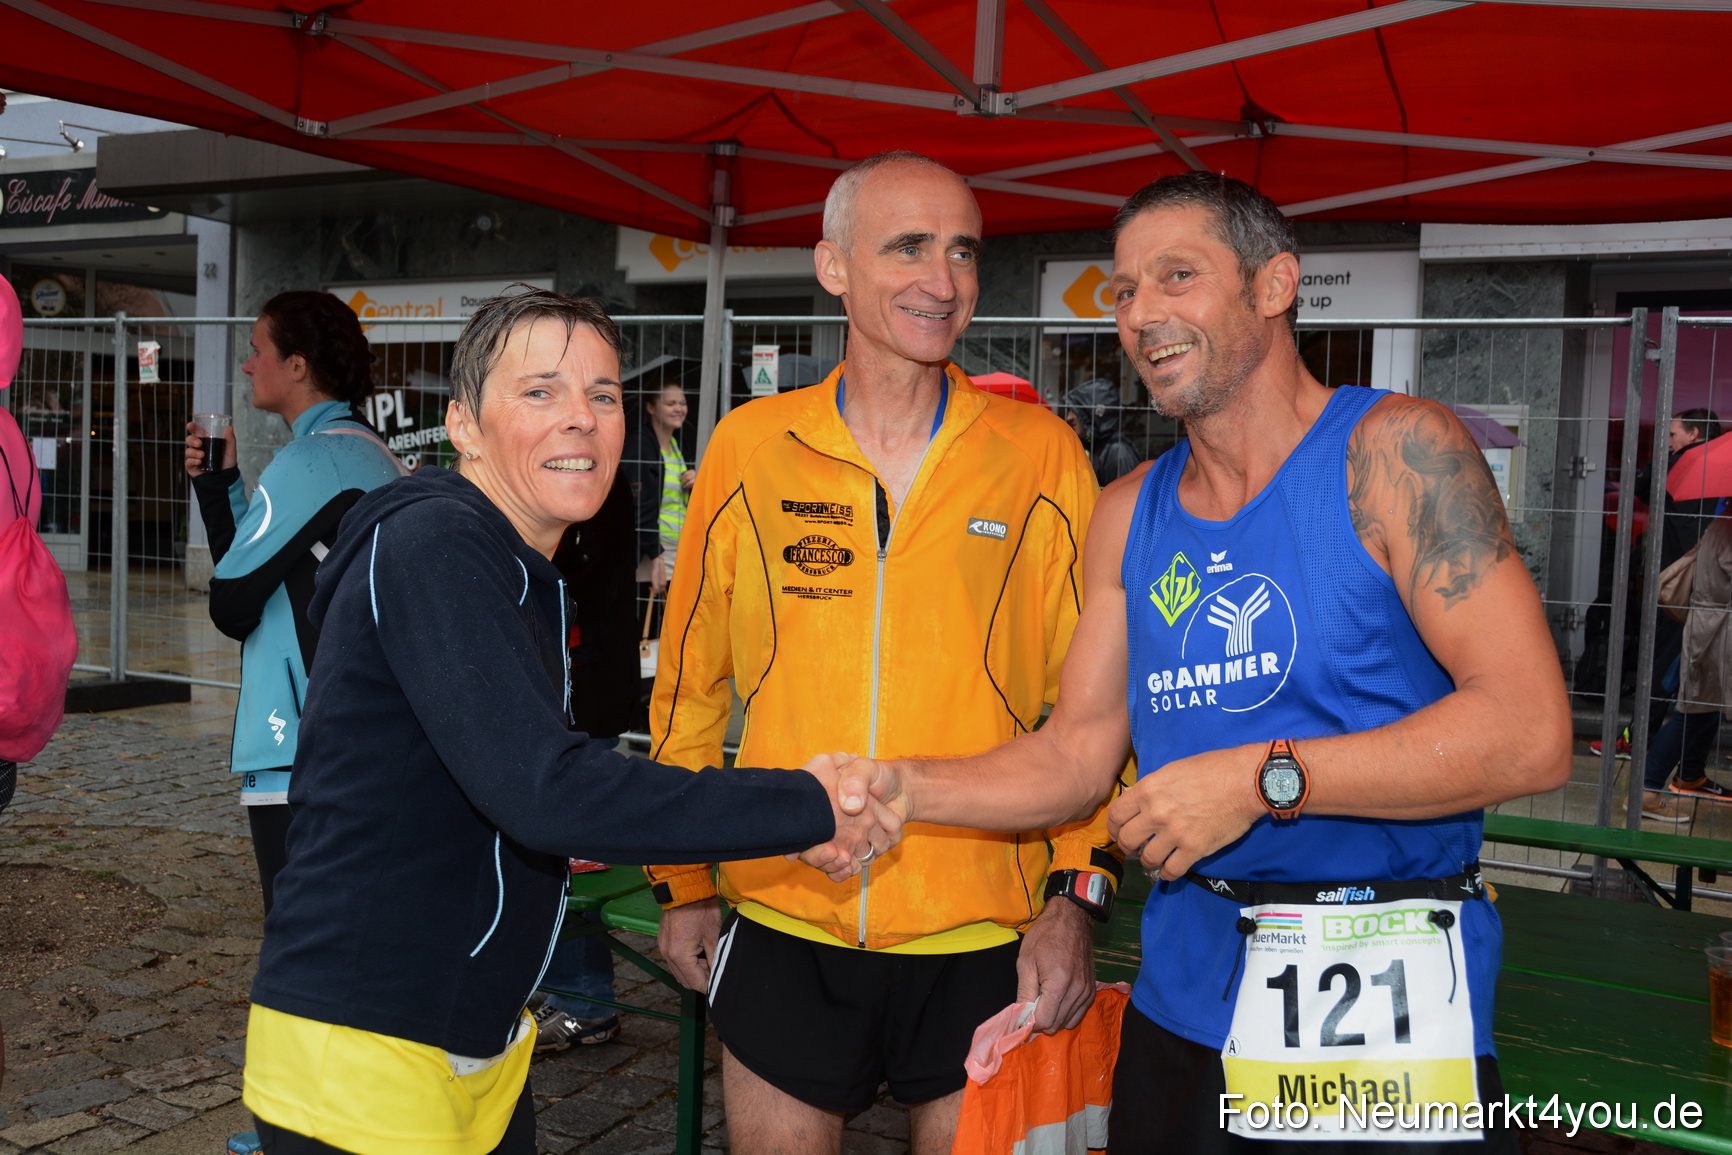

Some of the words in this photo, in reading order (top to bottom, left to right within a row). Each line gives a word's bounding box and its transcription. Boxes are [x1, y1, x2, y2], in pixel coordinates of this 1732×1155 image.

[1299, 271, 1351, 286] anent
[1310, 296, 1332, 310] up
[791, 502, 853, 517] SPORTWEISS
[983, 521, 1006, 535] RONO
[797, 536, 838, 549] PIZZERIA
[791, 548, 844, 564] FRANCESCO
[1207, 563, 1233, 574] erima
[1147, 652, 1280, 694] GRAMMER
[1151, 689, 1218, 713] SOLAR
[1316, 886, 1376, 905] sailfish
[1322, 908, 1439, 942] BOCK
[1321, 940, 1359, 952] inspired
[1359, 939, 1369, 949] by
[1372, 938, 1398, 948] smart
[1401, 936, 1442, 947] concepts
[1266, 959, 1412, 1048] 121
[1228, 1040, 1236, 1054] A
[1278, 1072, 1412, 1107] Michael
